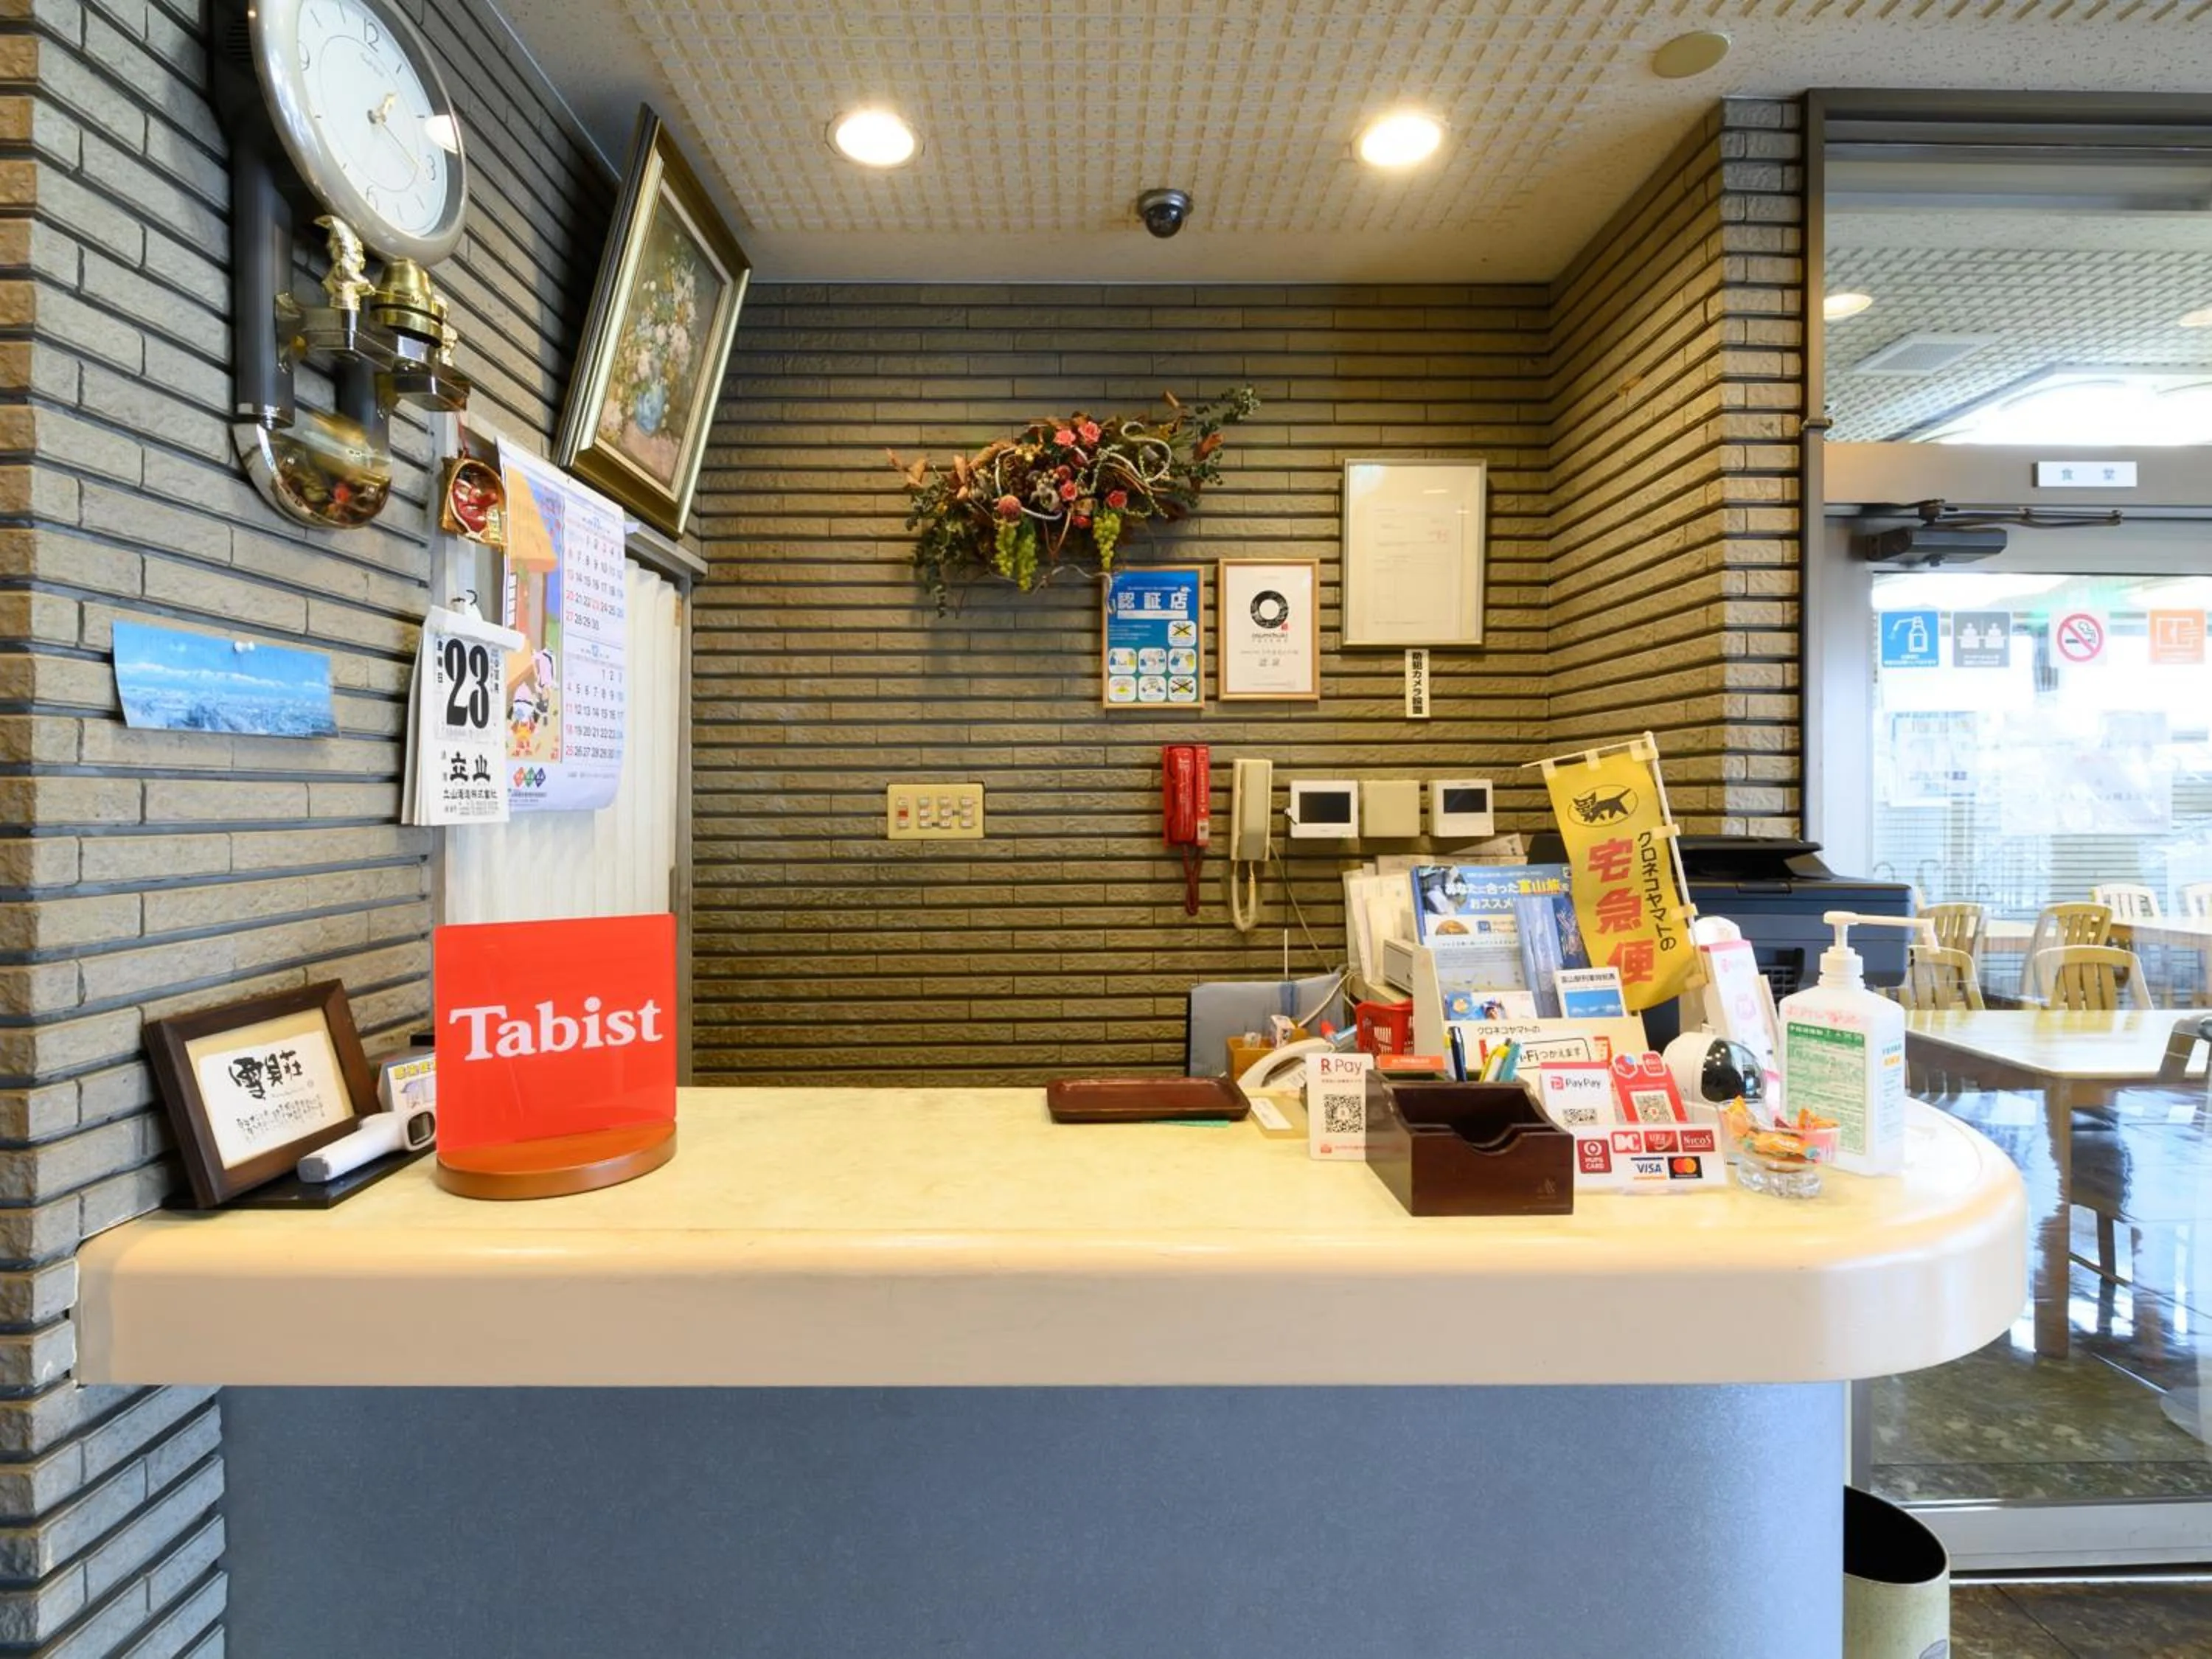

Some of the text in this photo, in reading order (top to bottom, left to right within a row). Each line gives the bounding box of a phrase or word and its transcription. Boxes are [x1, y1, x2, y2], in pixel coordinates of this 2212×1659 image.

[445, 638, 490, 729] 23
[450, 751, 491, 782] 立山
[1587, 837, 1655, 987] 宅急便
[1638, 830, 1677, 953] クロネコヤマトの
[448, 996, 664, 1061] Tabist
[1335, 1058, 1363, 1076] Pay
[1565, 1077, 1601, 1089] PayPay
[1637, 1163, 1663, 1174] VISA
